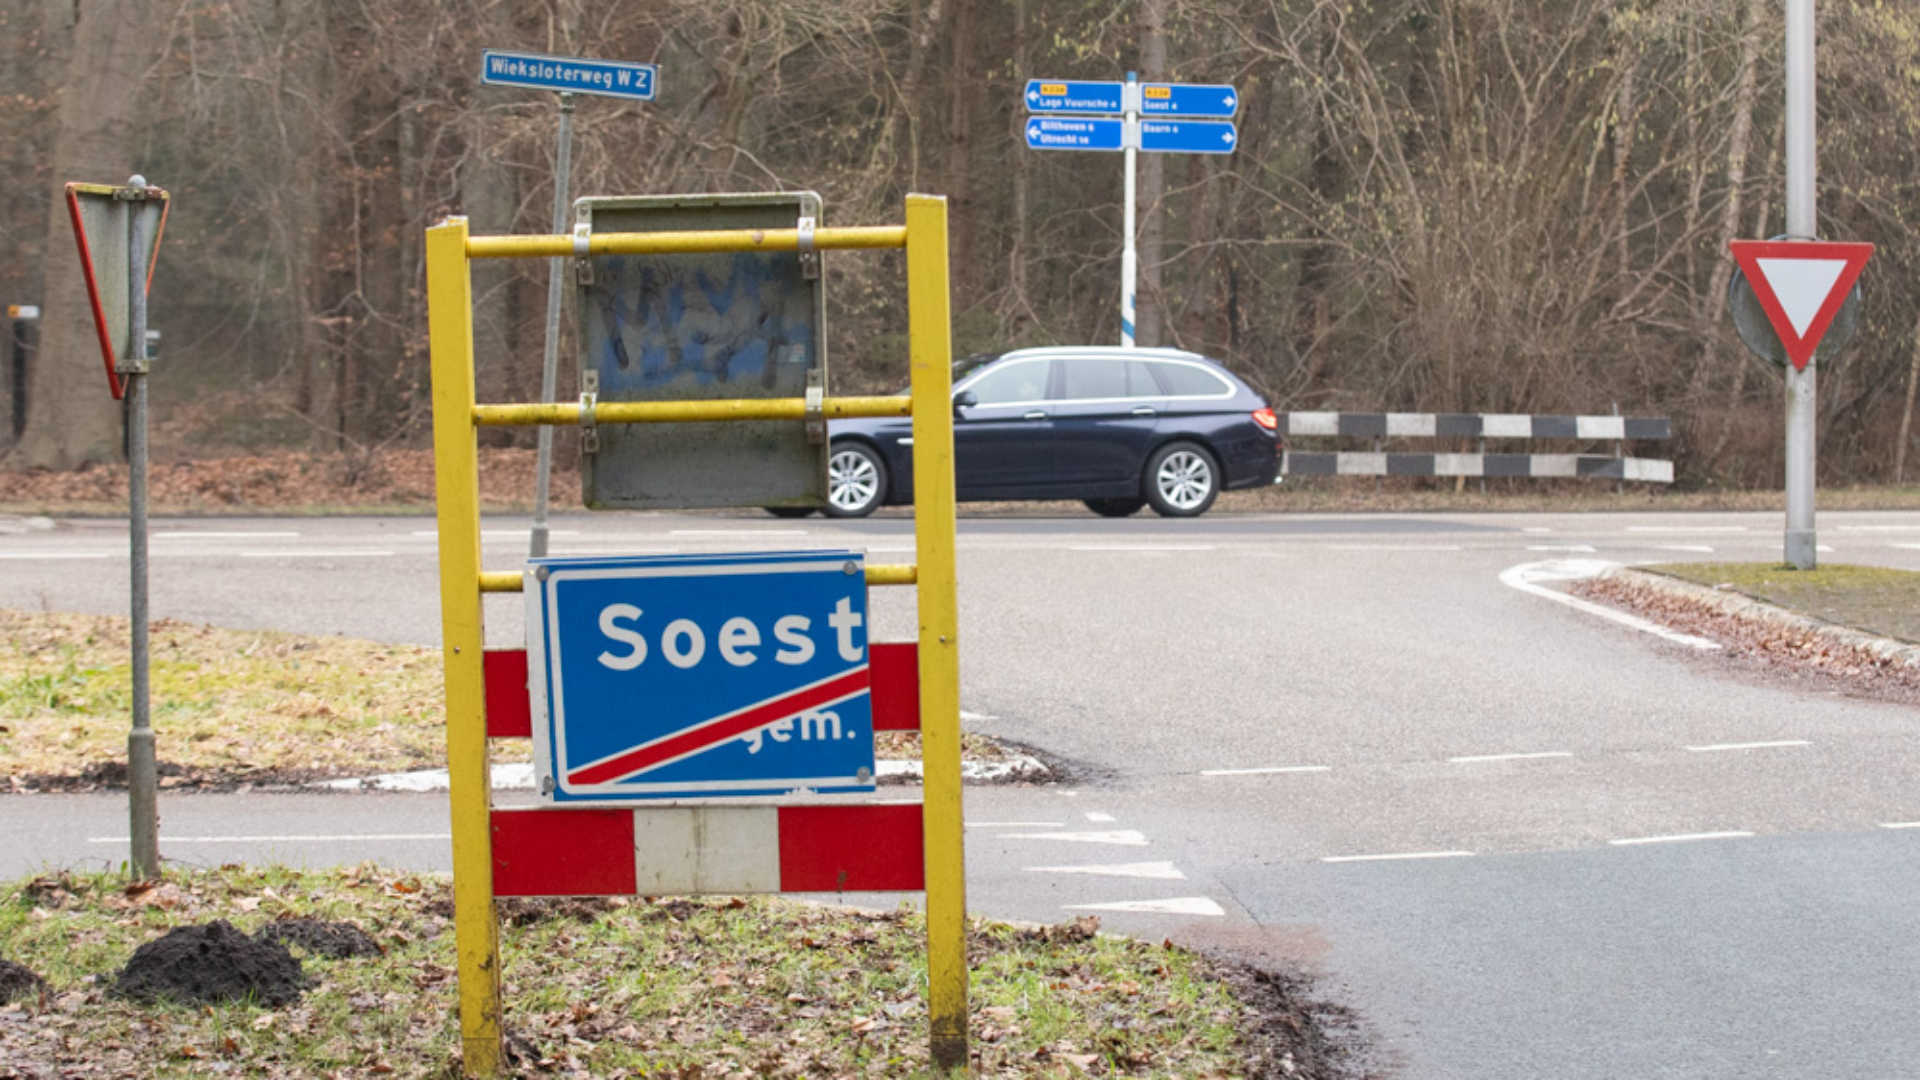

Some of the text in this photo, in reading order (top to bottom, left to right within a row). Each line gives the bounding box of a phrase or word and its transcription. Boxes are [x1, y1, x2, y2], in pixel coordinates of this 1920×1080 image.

[491, 57, 648, 89] Wieksloterweg W Z
[1040, 98, 1062, 109] Lage
[1064, 98, 1109, 109] Vuursche
[1144, 100, 1169, 111] Soest
[1041, 121, 1087, 132] Bilthoven
[1142, 122, 1171, 133] Baarn
[1041, 133, 1077, 144] Utrecht
[597, 595, 865, 672] Soest
